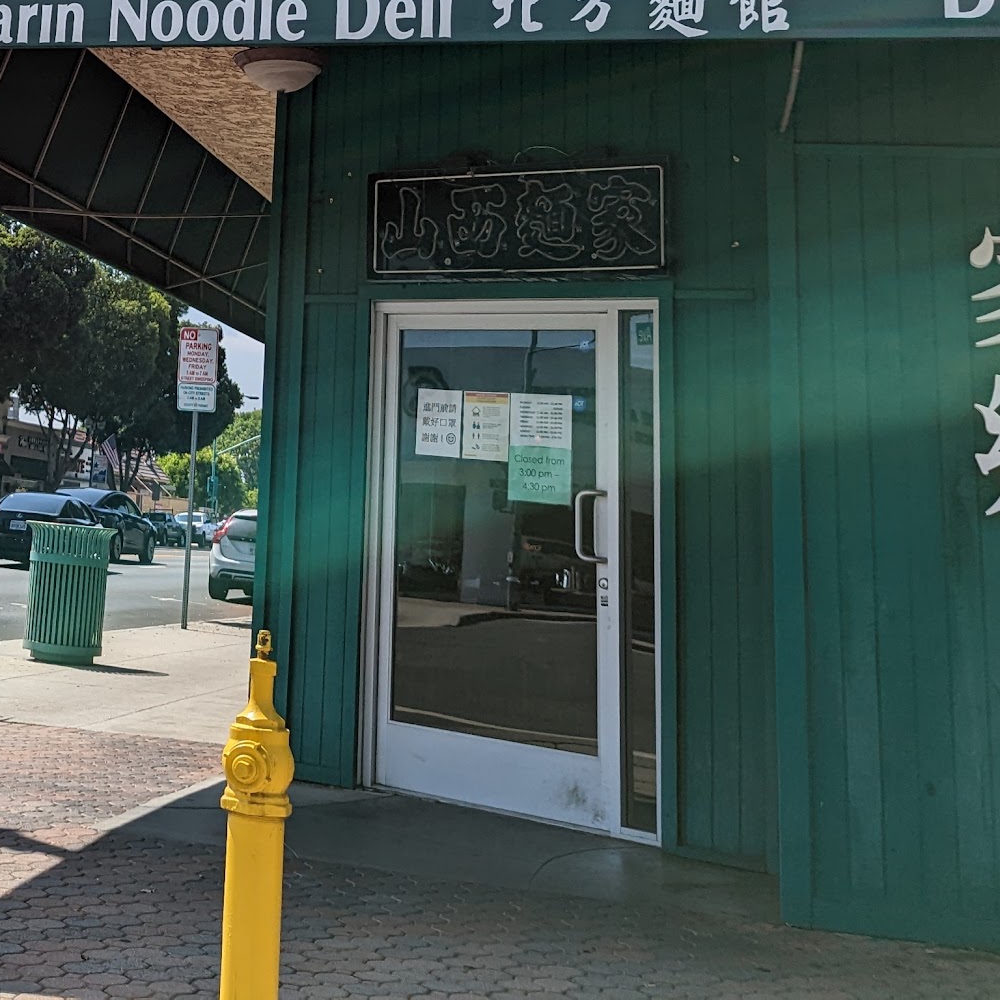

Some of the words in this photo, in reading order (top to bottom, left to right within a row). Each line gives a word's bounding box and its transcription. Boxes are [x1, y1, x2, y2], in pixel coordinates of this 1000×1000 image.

[183, 330, 196, 340] NO
[186, 342, 212, 350] PARKING
[514, 454, 544, 464] Closed
[546, 456, 565, 465] from
[519, 468, 536, 477] 3:00
[538, 471, 552, 479] pm
[522, 482, 540, 490] 4:30
[542, 485, 556, 493] pm
